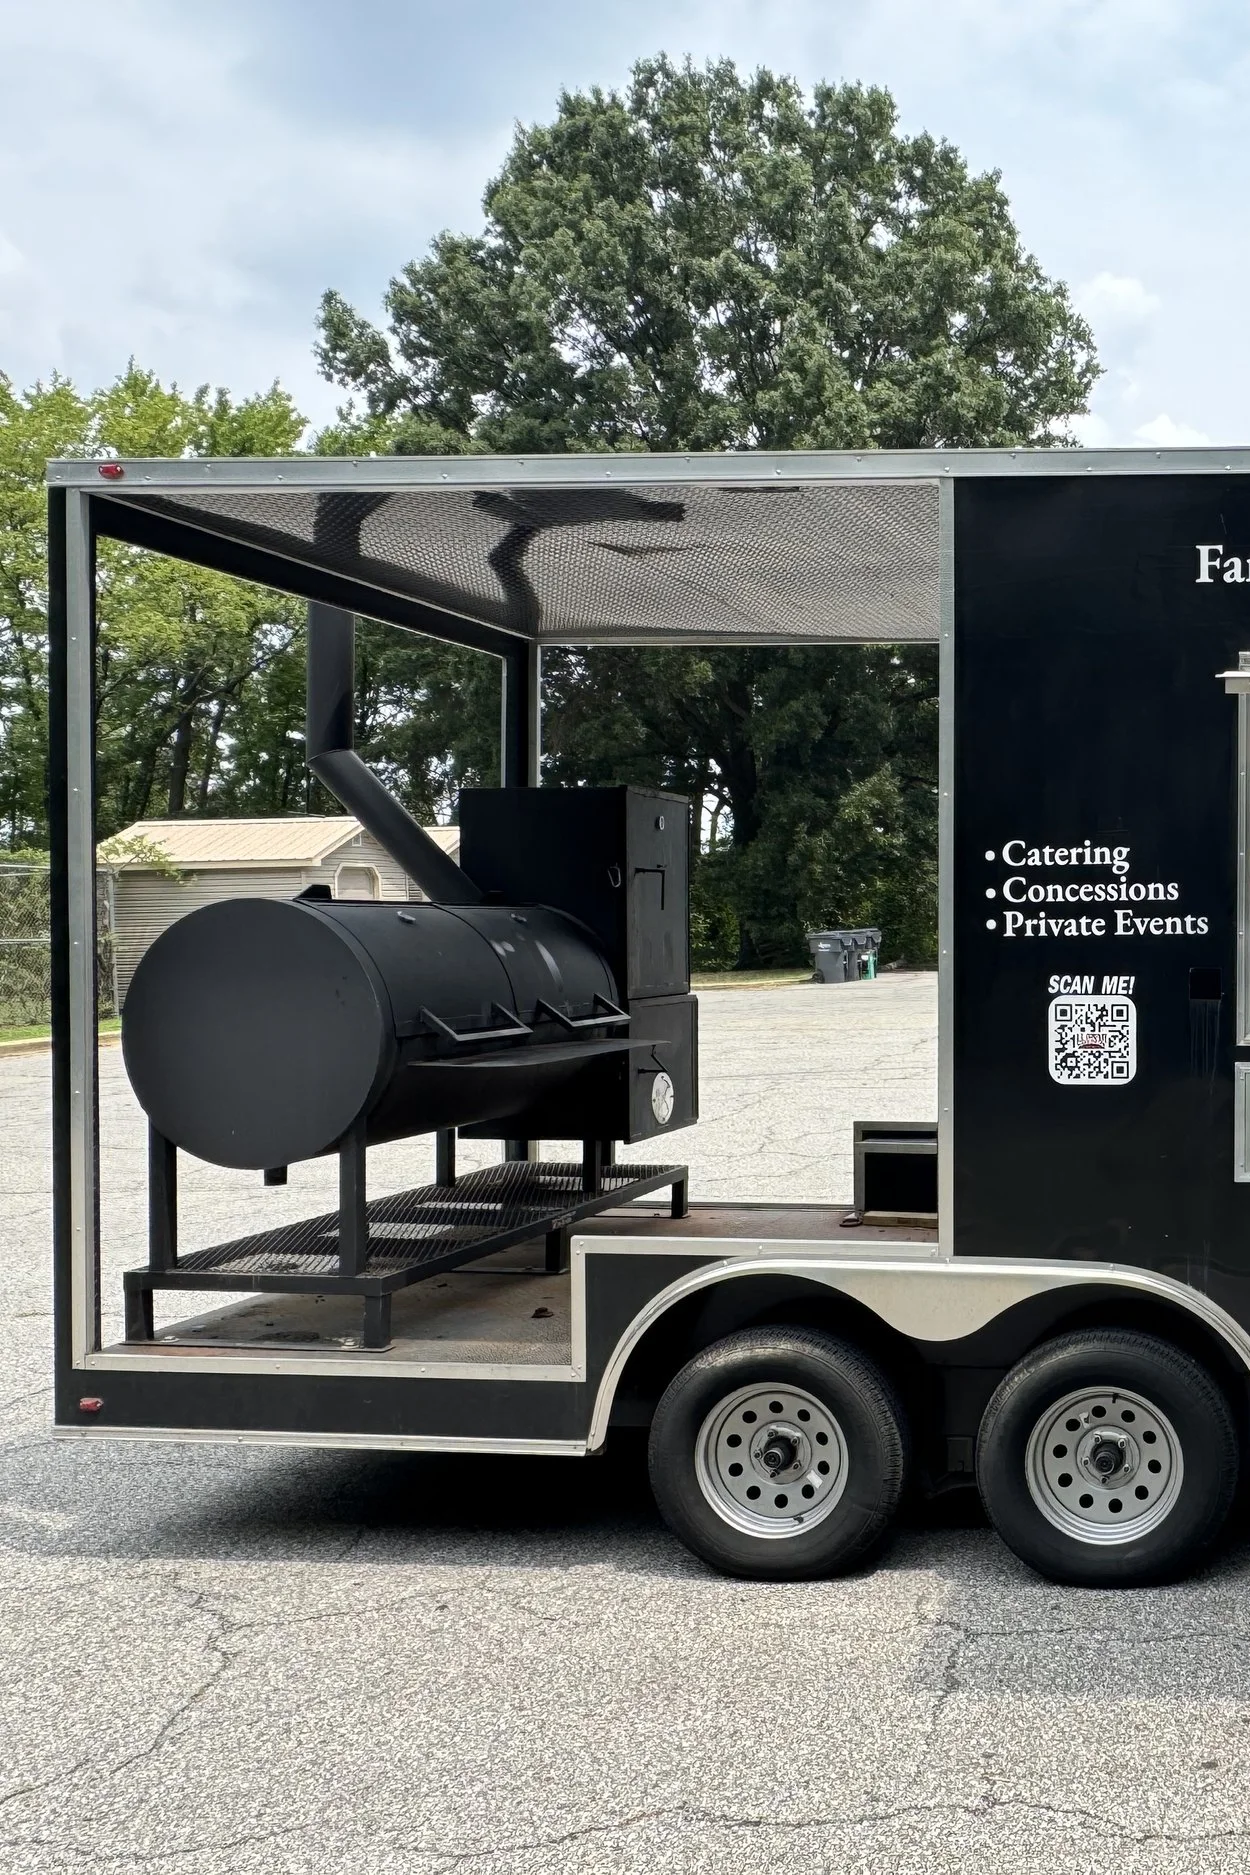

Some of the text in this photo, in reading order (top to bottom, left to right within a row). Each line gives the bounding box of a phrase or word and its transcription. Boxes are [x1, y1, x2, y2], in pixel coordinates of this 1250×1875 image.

[1002, 840, 1130, 874] Catering
[1003, 876, 1178, 902] Concessions
[1003, 910, 1209, 937] Private Events
[1048, 975, 1135, 994] SCAN ME!
